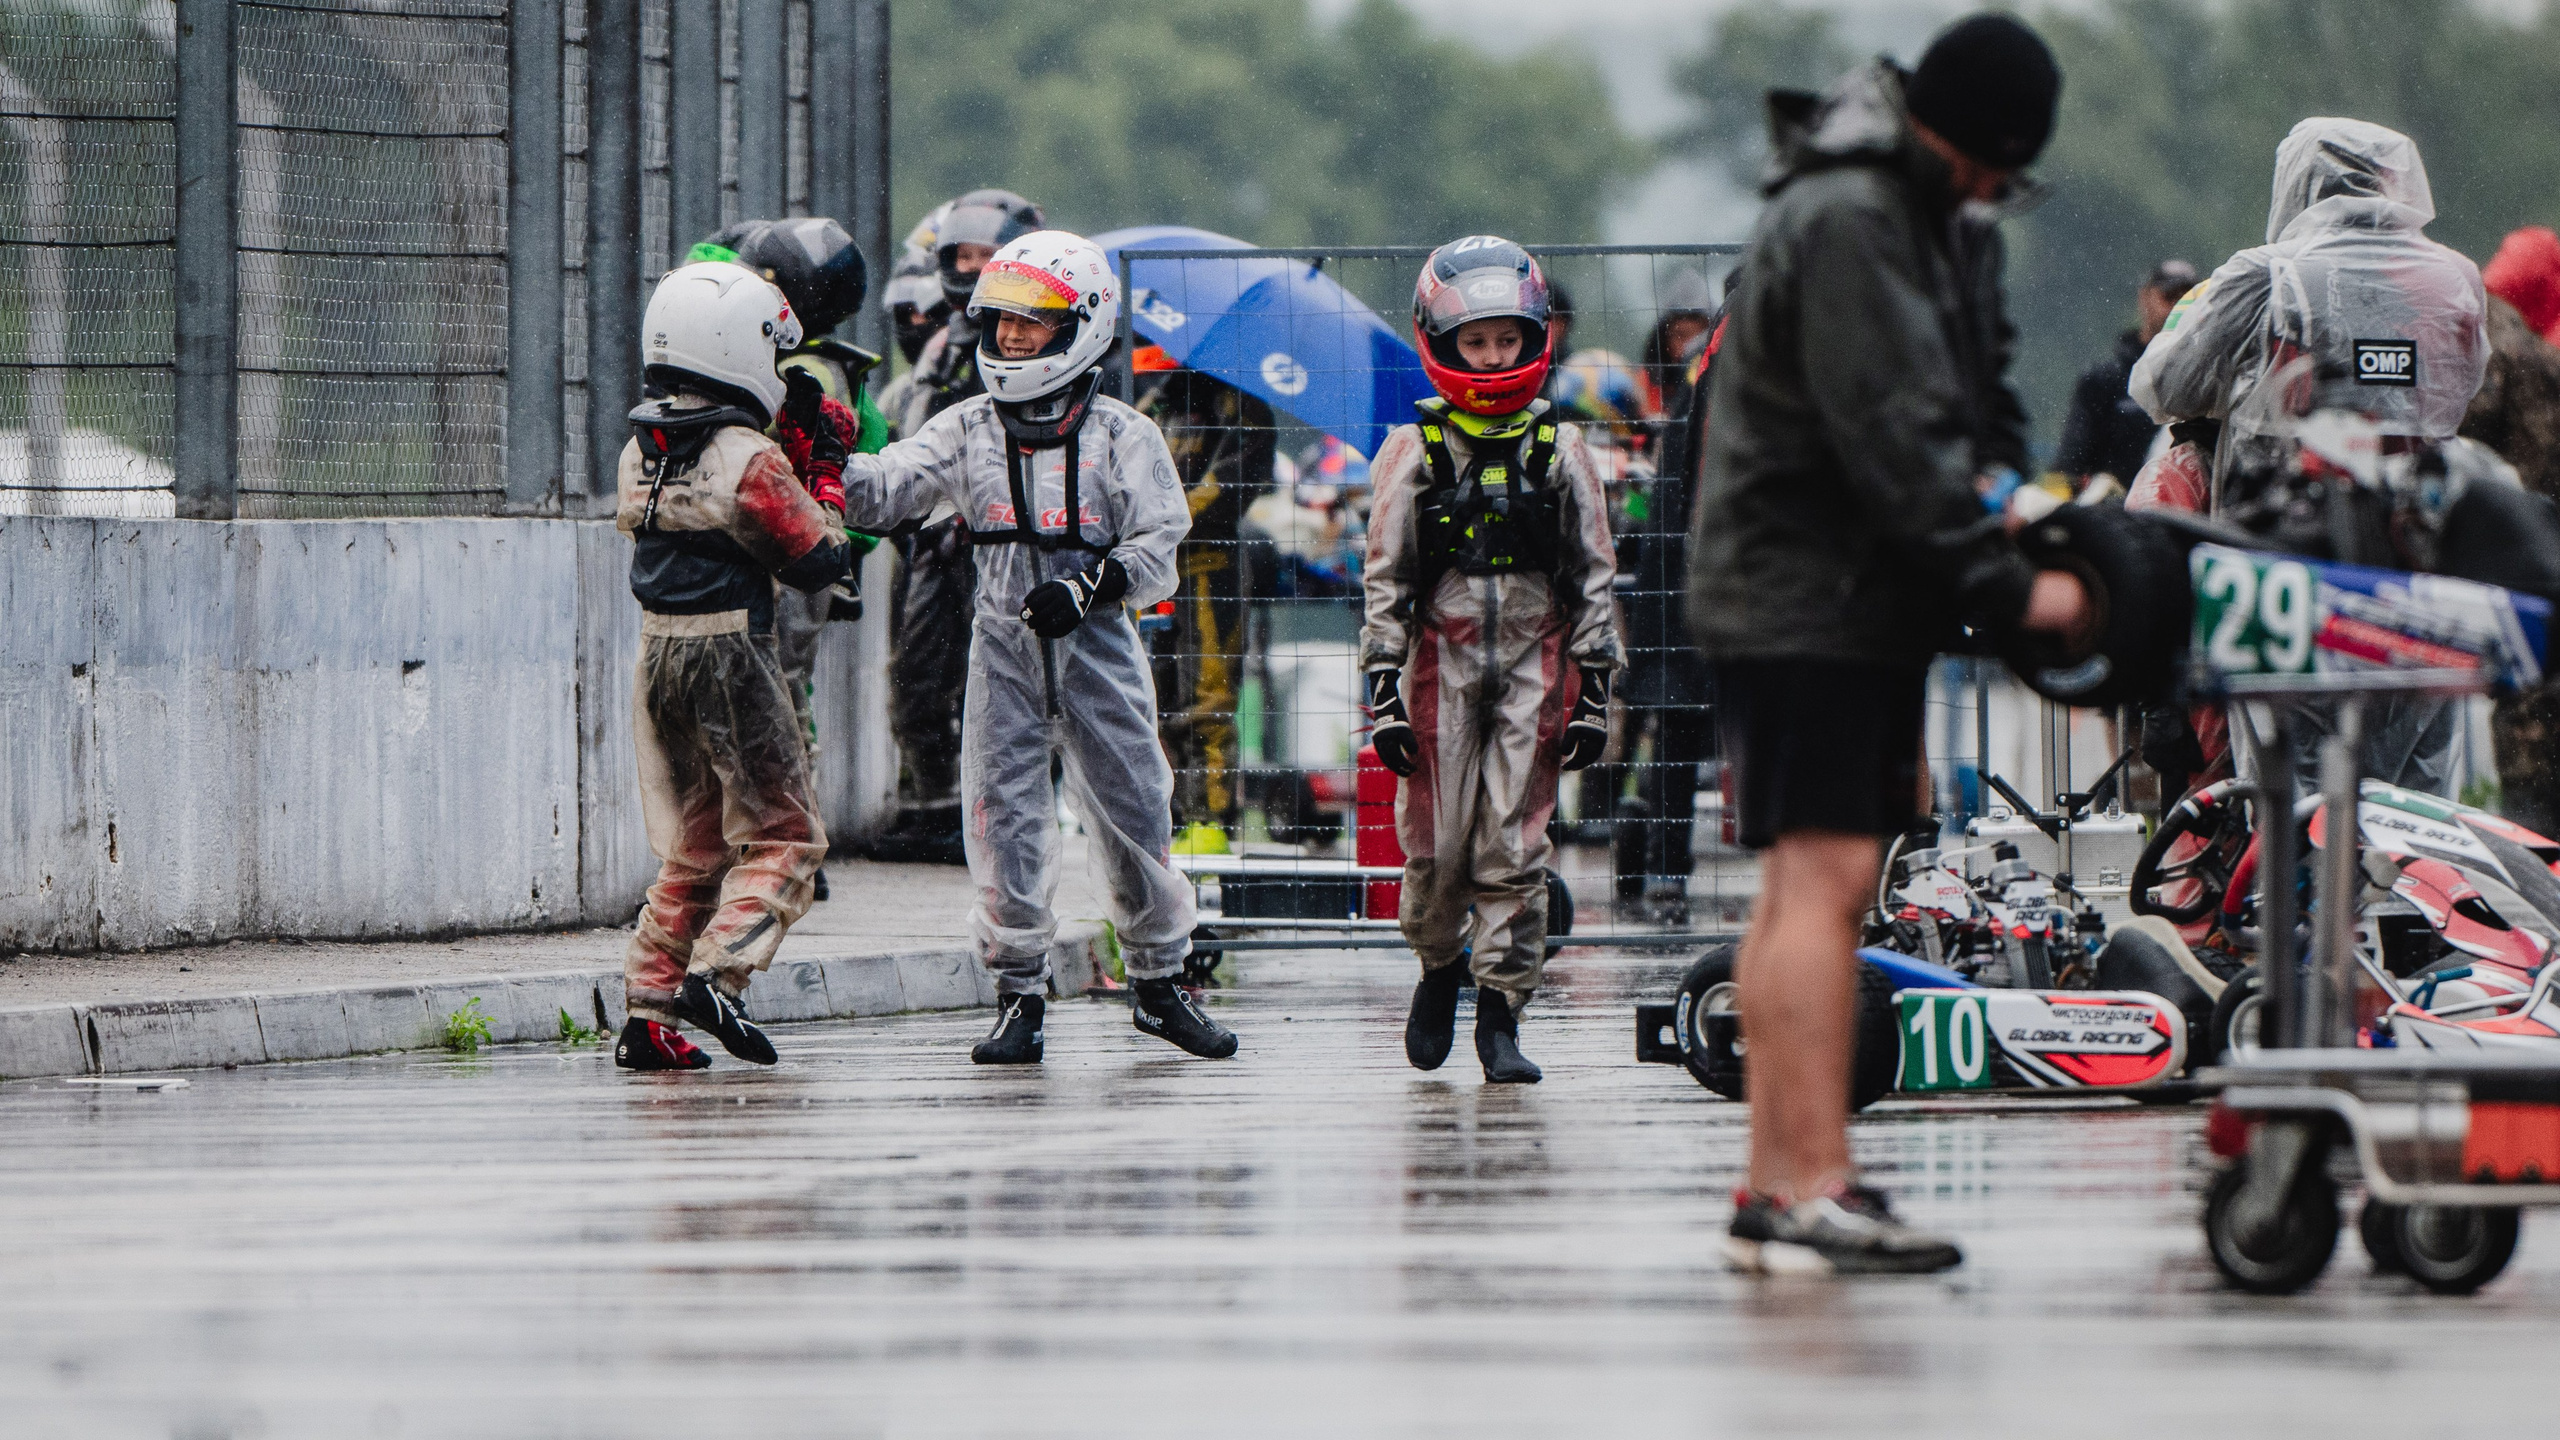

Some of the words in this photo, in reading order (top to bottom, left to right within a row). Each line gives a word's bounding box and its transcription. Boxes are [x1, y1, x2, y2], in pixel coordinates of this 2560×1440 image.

[2359, 351, 2411, 373] OMP
[1480, 470, 1507, 481] OMP
[2202, 555, 2310, 670] 29
[1910, 996, 1985, 1085] 10
[2008, 1028, 2075, 1044] GLOBAL
[2080, 1030, 2146, 1045] RACING
